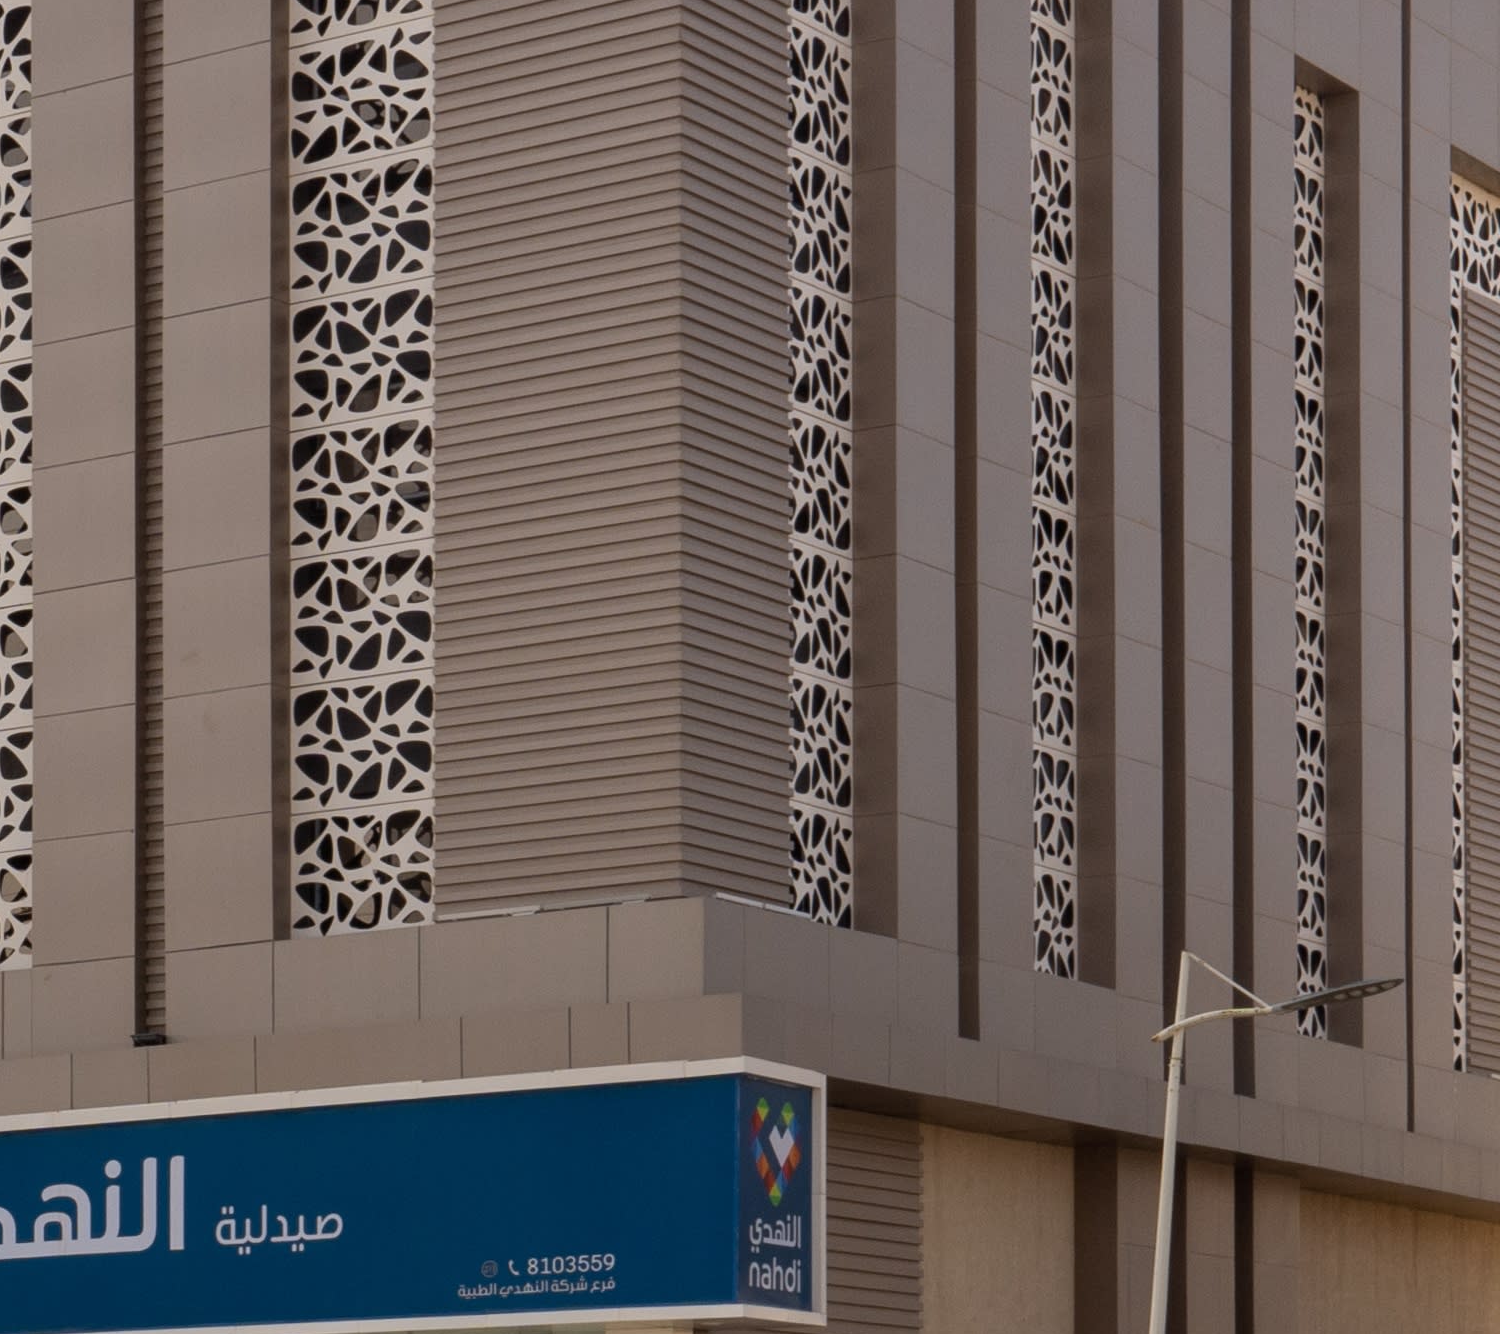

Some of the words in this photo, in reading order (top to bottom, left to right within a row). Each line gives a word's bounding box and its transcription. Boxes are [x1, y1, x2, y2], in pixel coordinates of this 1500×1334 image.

[214, 1204, 344, 1255] صيدلية
[749, 1215, 802, 1253] النهدي
[527, 1253, 616, 1276] 8103559
[551, 1275, 588, 1295] شركة
[590, 1276, 616, 1294] فرع
[749, 1257, 802, 1294] nahdi
[457, 1282, 497, 1300] الطبية
[499, 1279, 549, 1298] النهدي
